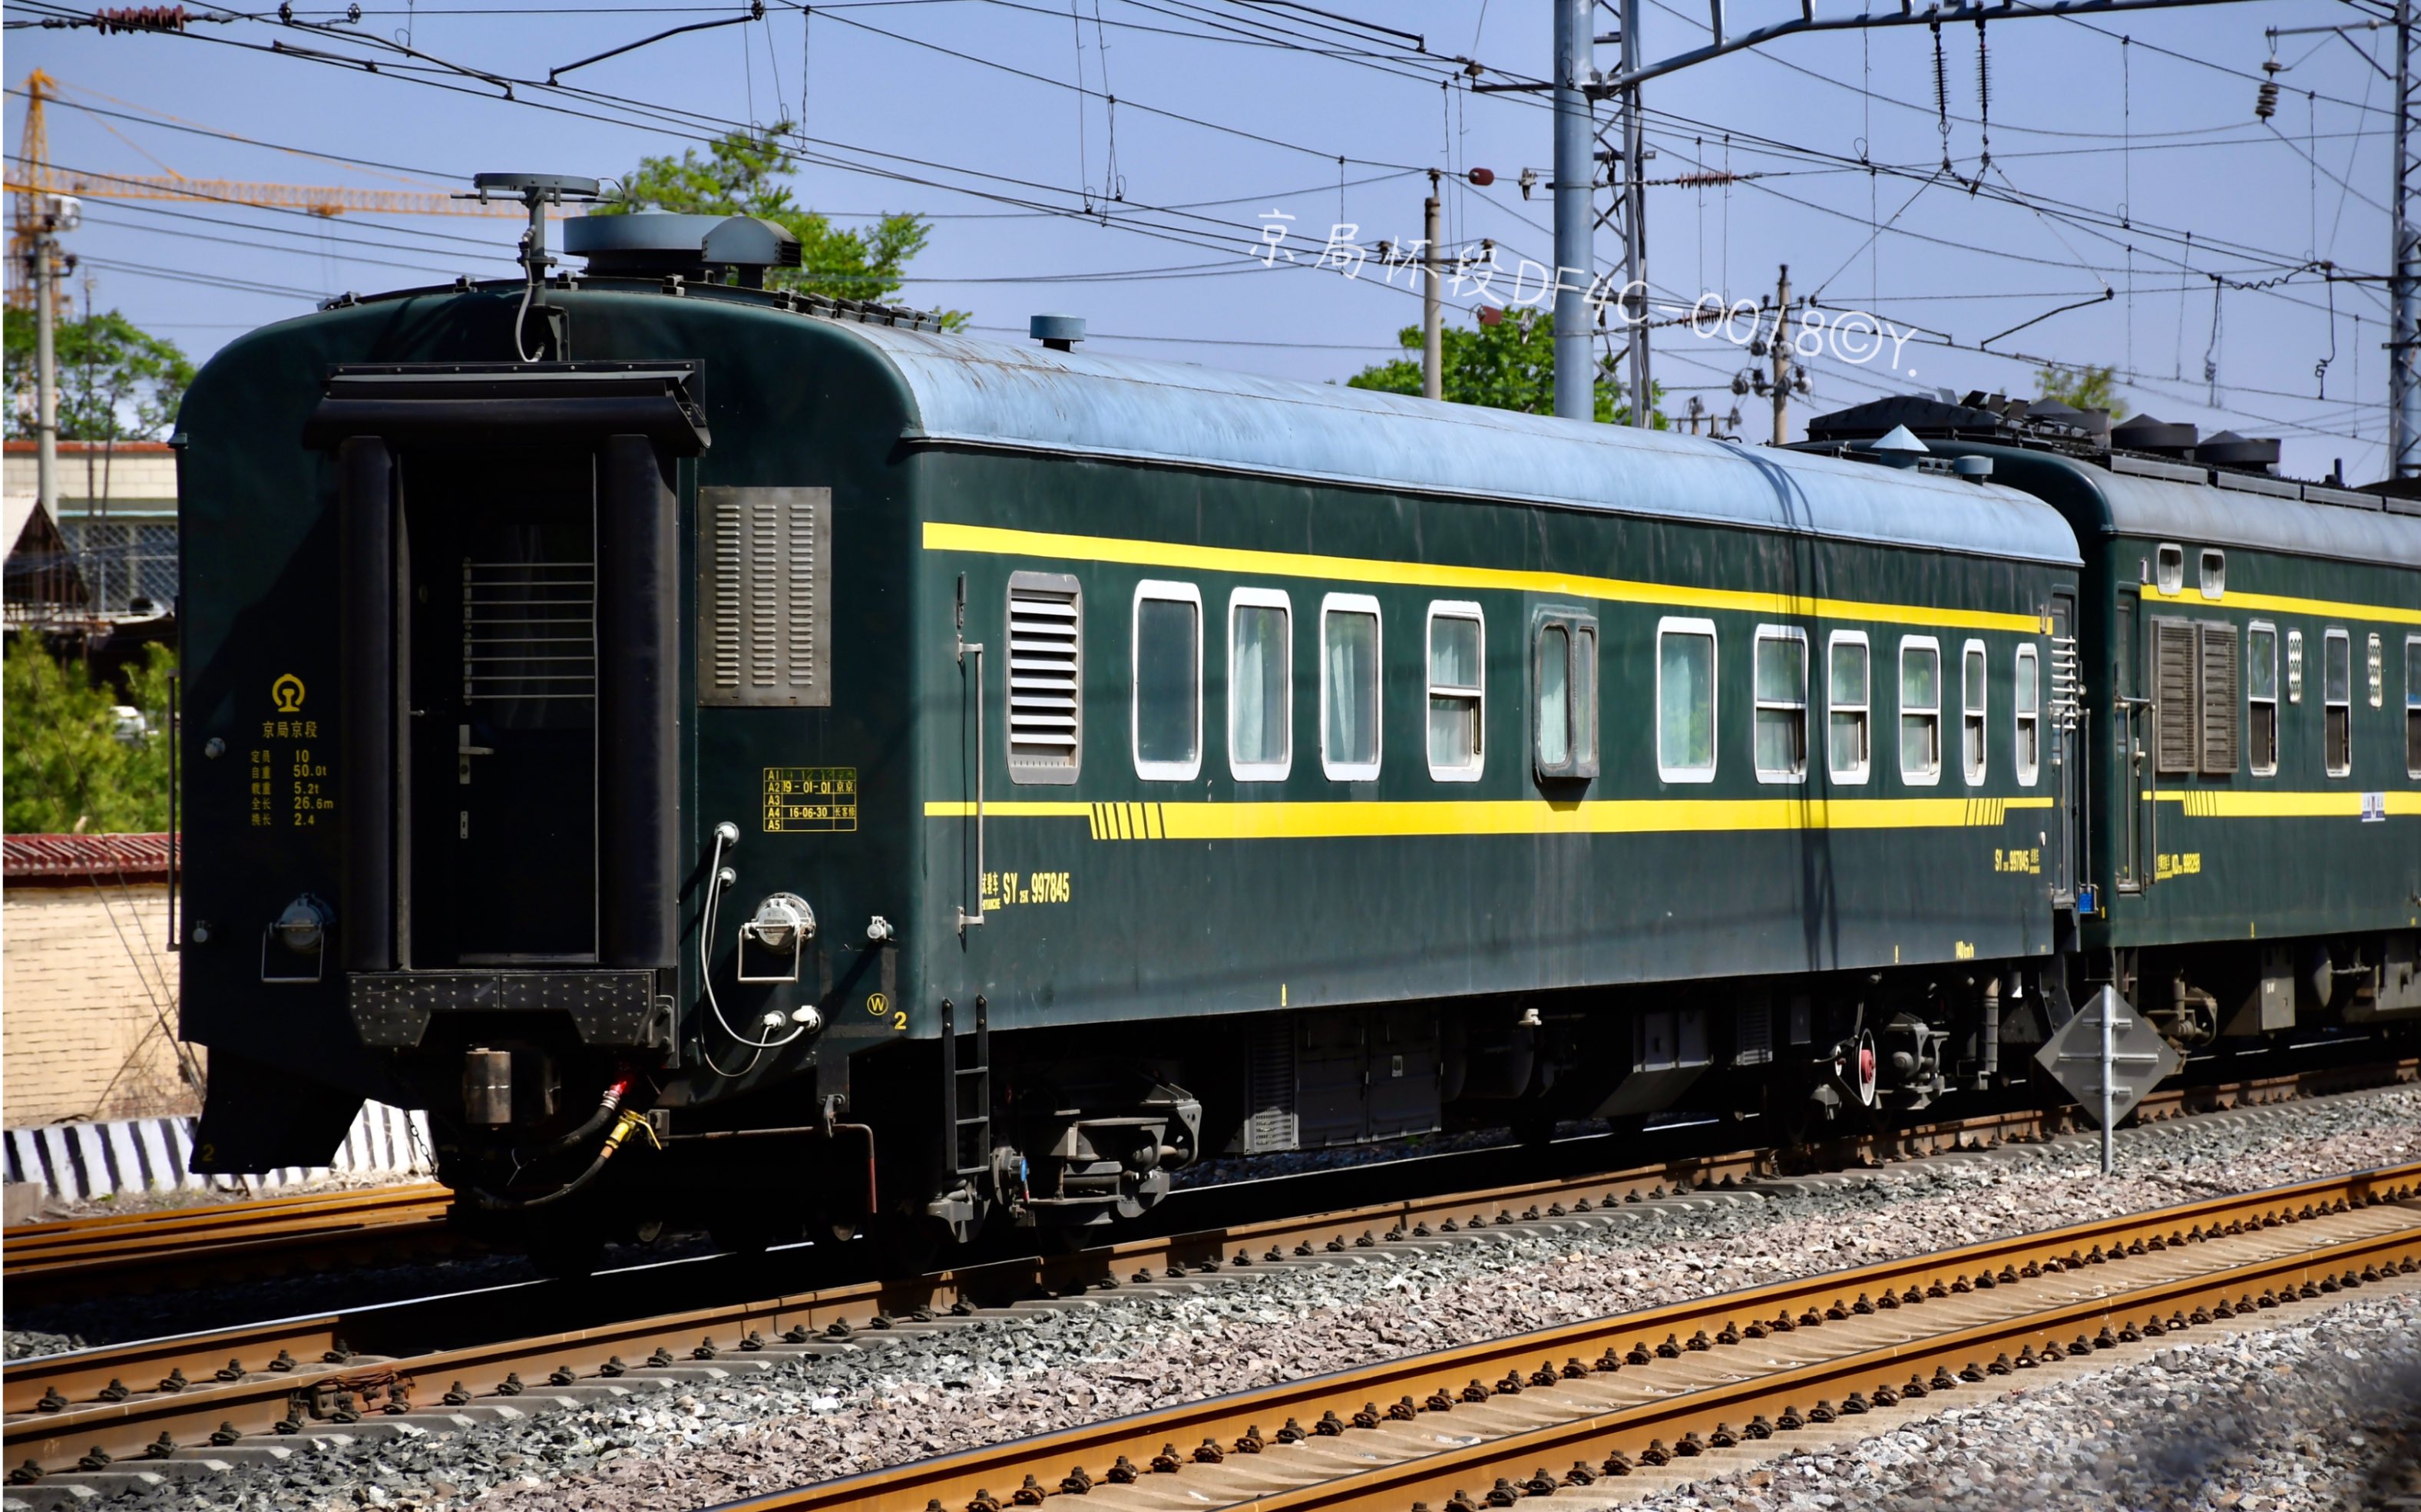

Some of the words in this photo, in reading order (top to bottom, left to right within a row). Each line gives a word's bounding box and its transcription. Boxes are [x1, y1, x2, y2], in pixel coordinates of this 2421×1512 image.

[262, 720, 318, 739] 京局京段
[251, 749, 271, 763] 定员
[295, 749, 309, 763] 10
[251, 766, 271, 779] 自重
[293, 764, 327, 778] 50.0t
[768, 769, 779, 781] A1
[251, 782, 271, 796] 载重
[294, 781, 319, 795] 5.2t
[768, 782, 780, 792] A2
[836, 780, 854, 792] 京京
[251, 797, 271, 810] 全长
[294, 796, 334, 809] 26.6m
[768, 794, 780, 806] A3
[251, 812, 271, 826] 换长
[294, 812, 315, 826] 2.4
[768, 807, 780, 818] A4
[789, 807, 828, 818] 16-06-30
[768, 819, 780, 830] A5
[1003, 872, 1018, 905] SY
[1031, 872, 1070, 903] 997845
[869, 995, 886, 1013] W
[894, 1011, 907, 1030] 2
[202, 1143, 215, 1162] 2
